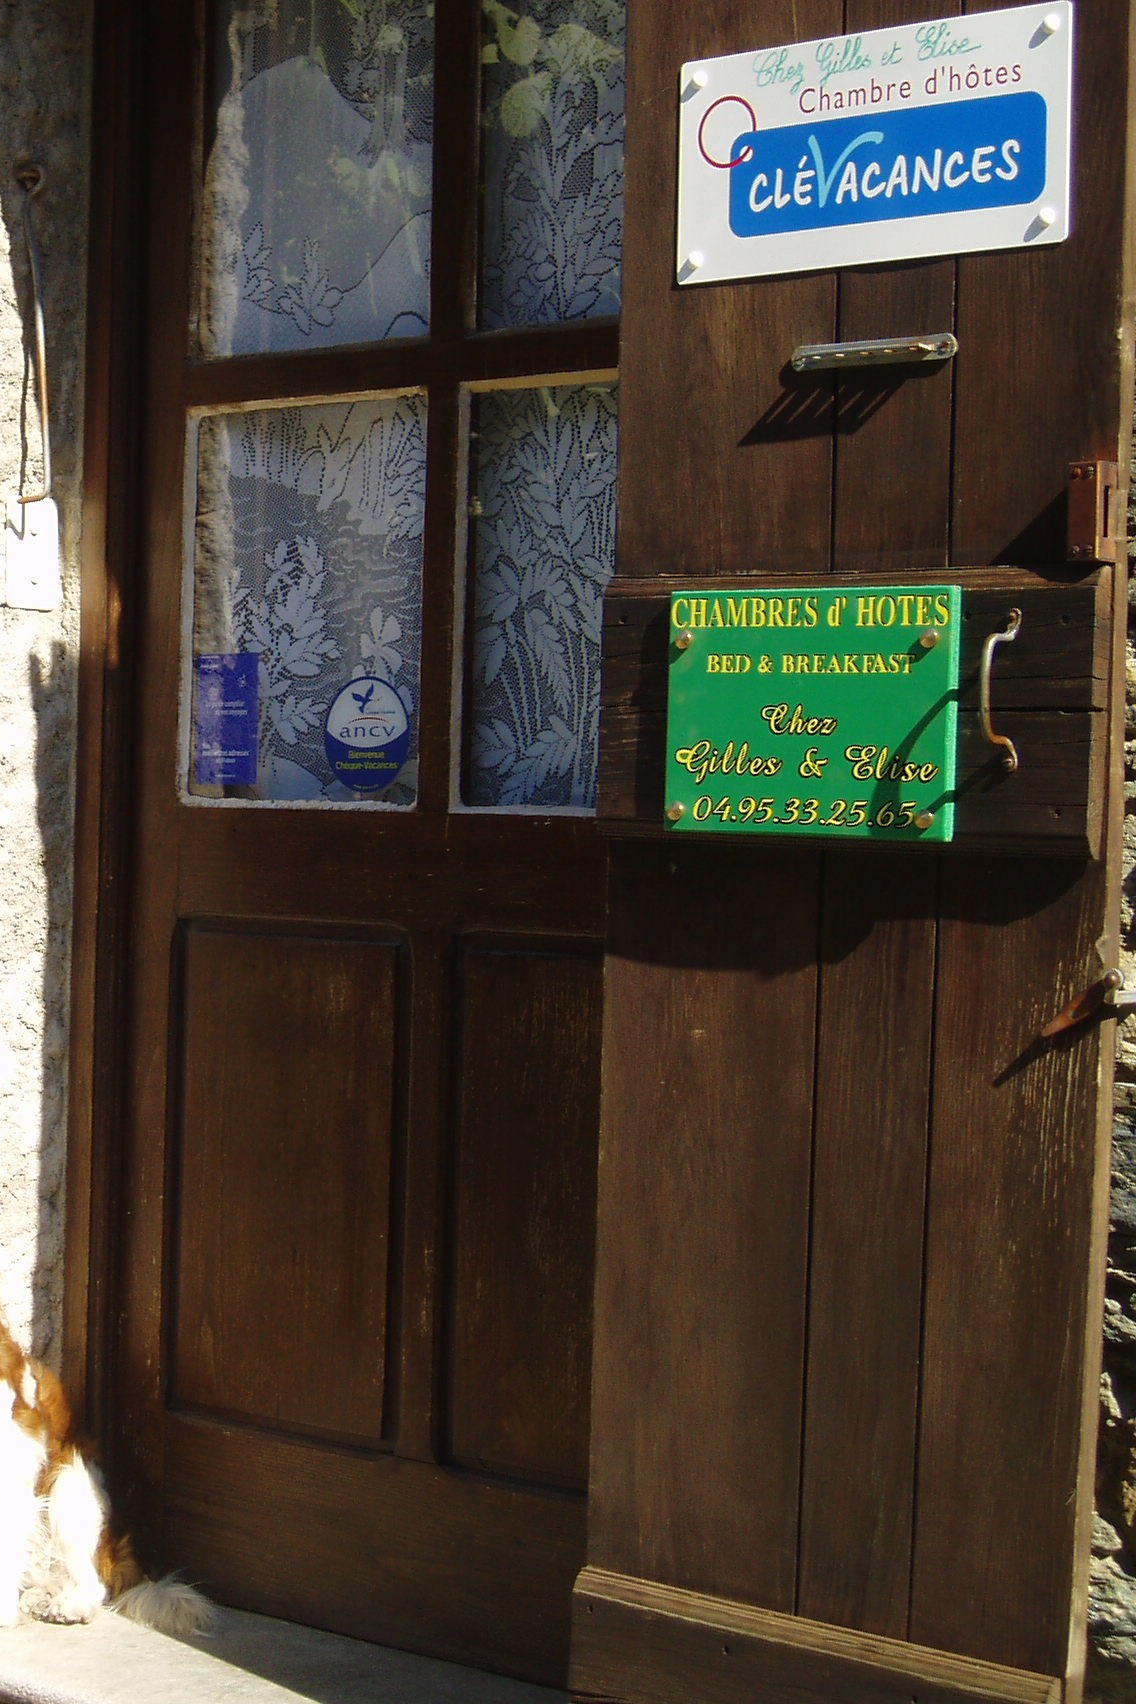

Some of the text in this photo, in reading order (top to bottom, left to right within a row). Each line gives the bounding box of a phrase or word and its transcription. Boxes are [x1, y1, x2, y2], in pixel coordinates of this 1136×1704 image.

[753, 22, 981, 95] Chez Gilles et Elise
[799, 63, 1023, 114] Chambre d'hôtes
[671, 594, 952, 629] CHAMBRES d' HOTES
[706, 653, 916, 675] BED & BREAKFAST
[339, 725, 396, 739] ancv
[761, 703, 838, 735] Chez
[675, 740, 940, 784] Gilles & Elise
[692, 795, 917, 828] 04.95.33.25.65
